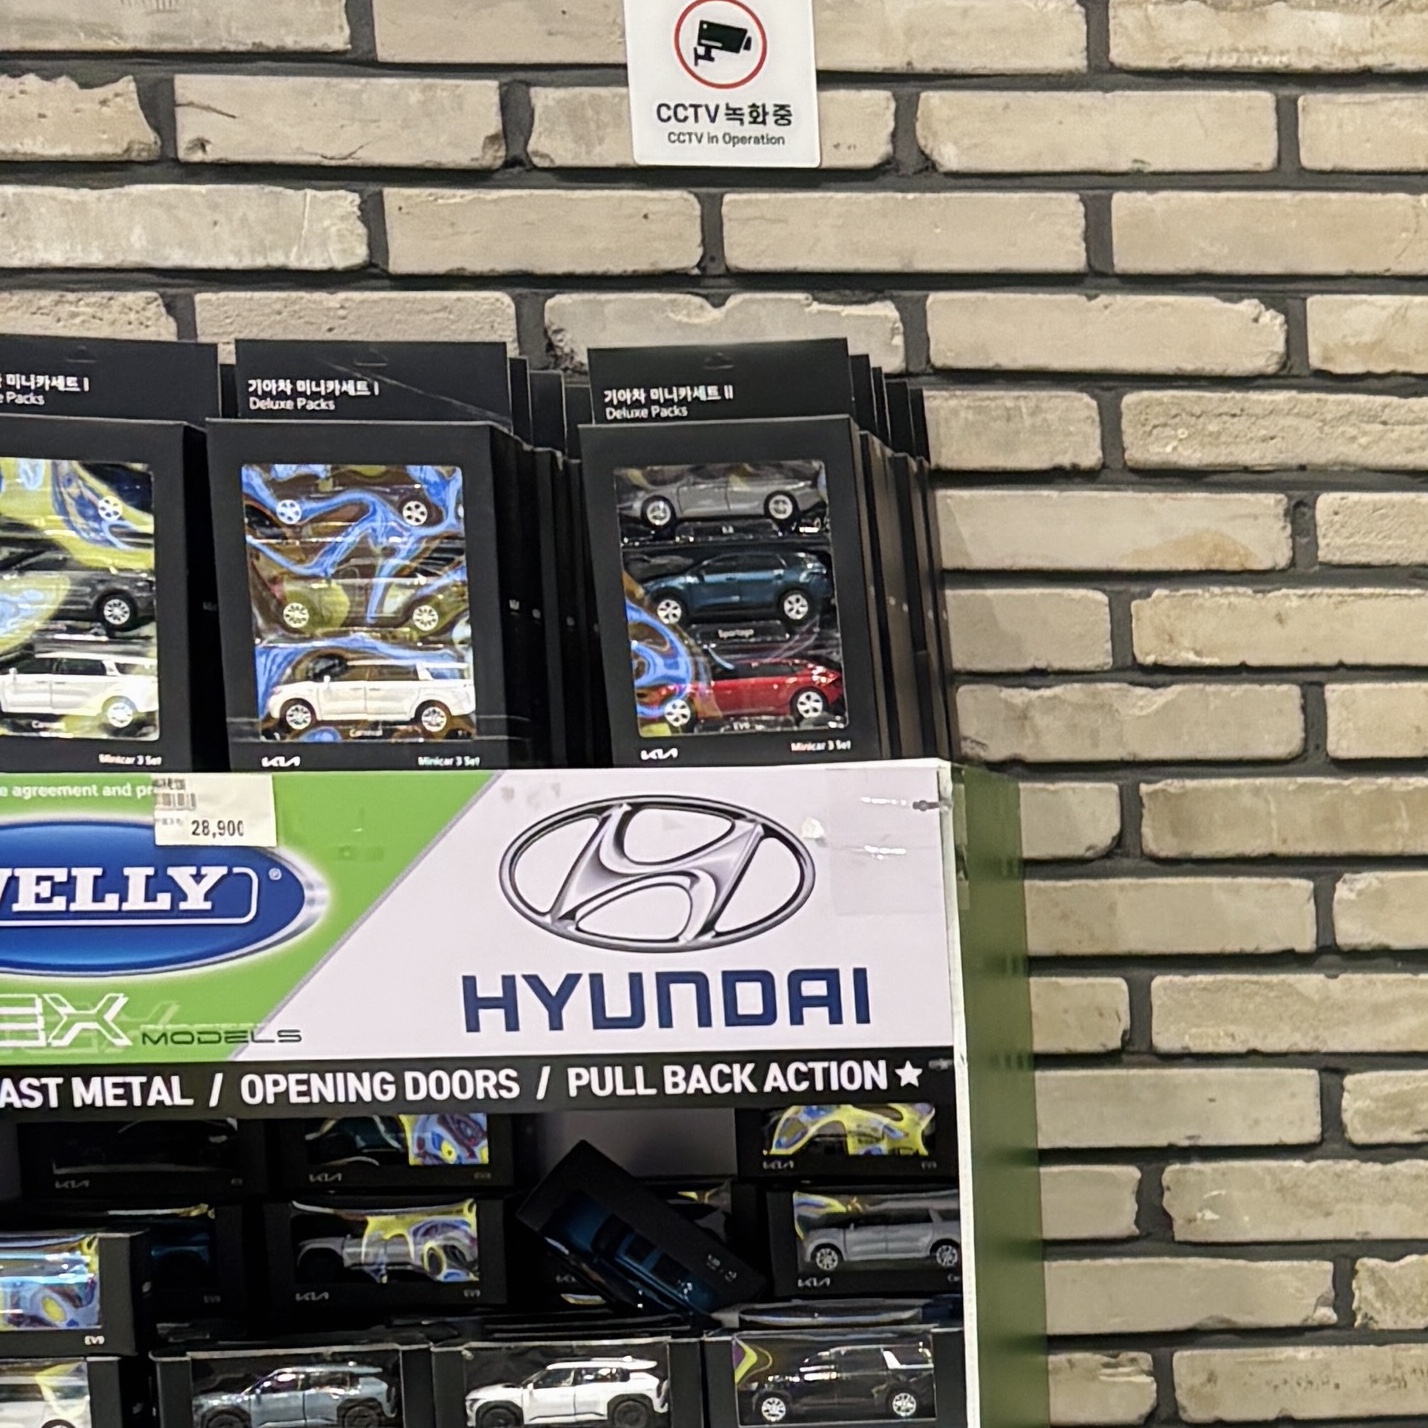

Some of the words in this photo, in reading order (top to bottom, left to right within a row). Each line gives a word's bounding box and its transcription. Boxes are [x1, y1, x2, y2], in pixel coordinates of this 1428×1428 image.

[656, 103, 720, 124] CCTV
[667, 131, 705, 144] CCTV
[707, 131, 719, 144] in
[722, 132, 785, 147] Operation
[6, 391, 45, 406] Packs
[250, 397, 294, 410] Deluxe
[297, 397, 335, 411] Packs
[605, 407, 648, 420] Deluxe
[652, 405, 688, 418] Packs
[12, 784, 99, 799] agreement
[102, 783, 133, 797] and
[461, 967, 871, 1033] HYUNDAI
[141, 1029, 302, 1045] MODELS
[72, 1075, 194, 1108] METAL
[241, 1072, 396, 1104] OPENING
[405, 1068, 520, 1100] DOORS
[567, 1066, 657, 1098] PULL
[663, 1063, 762, 1095] BACK
[763, 1060, 888, 1092] ACTION
